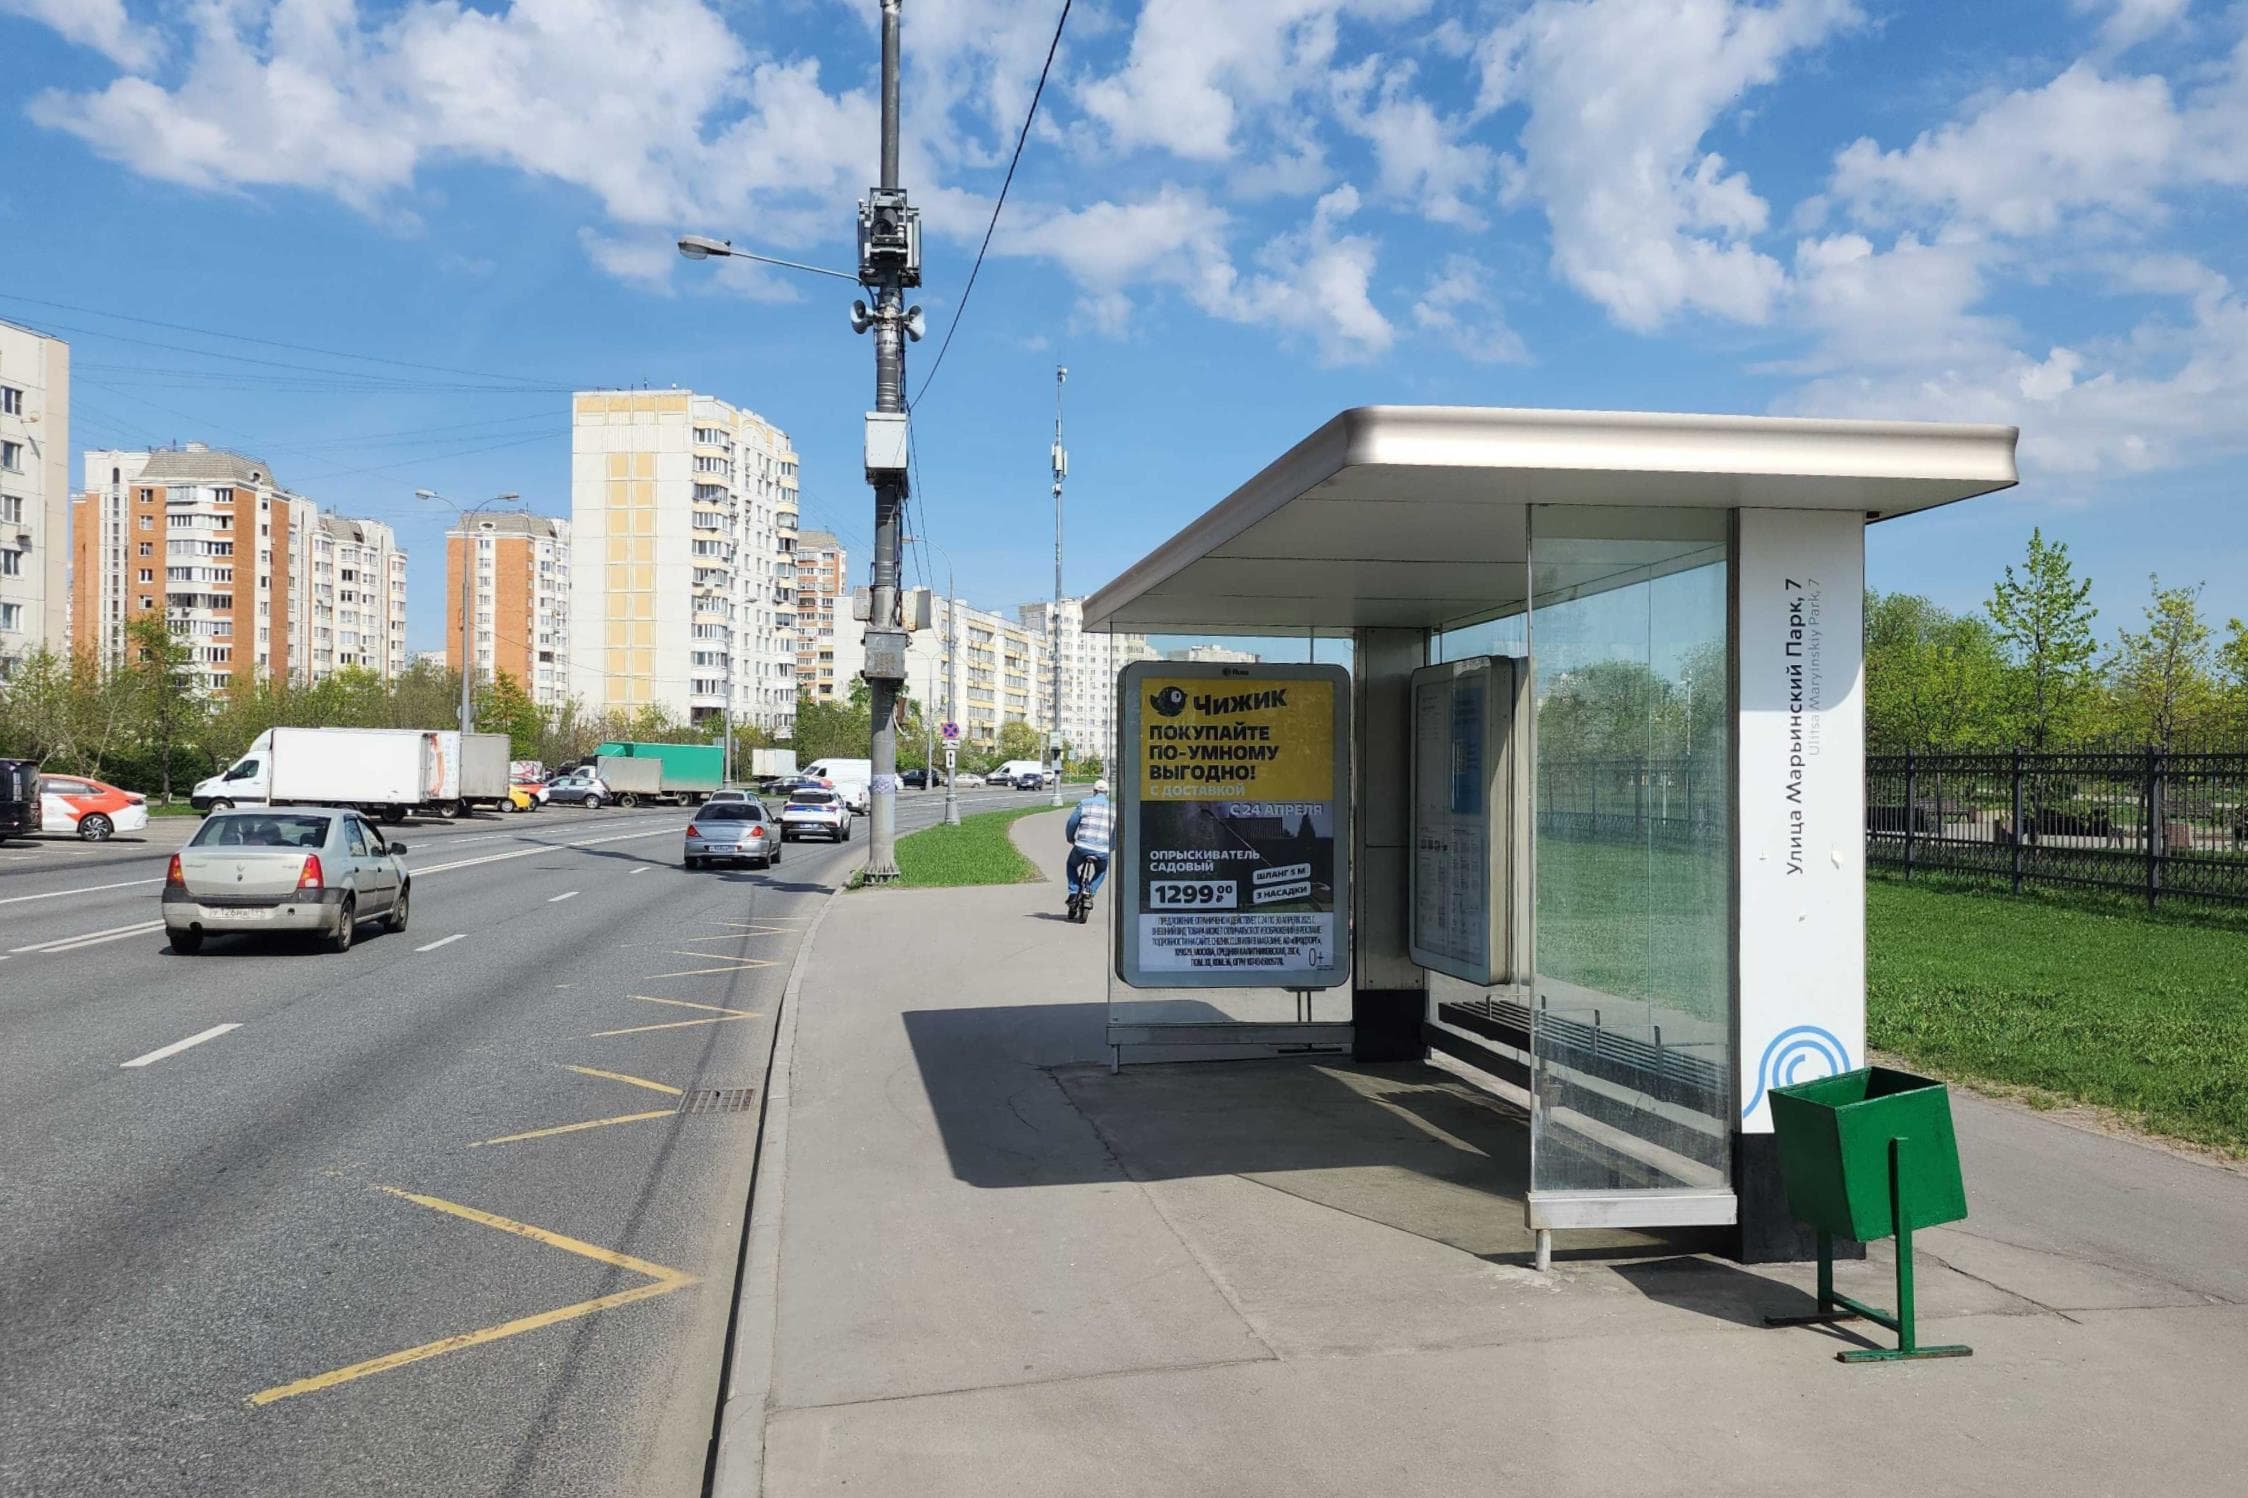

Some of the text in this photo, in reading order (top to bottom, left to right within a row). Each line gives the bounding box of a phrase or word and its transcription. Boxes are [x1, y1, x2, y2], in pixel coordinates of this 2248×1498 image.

[1808, 579, 1820, 587] 7
[1808, 630, 1823, 710] Maryinskiy
[1149, 722, 1270, 740] ПОКУПАЙТЕ
[1785, 579, 1805, 875] Улица Марьинский Парк, 7
[1808, 714, 1820, 756] Ulitsa
[1149, 745, 1279, 760] ПО-УМНОМУ
[1149, 765, 1255, 782] ВЫГОДНО!
[1161, 783, 1246, 797] ДОСТАВКОЙ
[1242, 804, 1261, 815] 24
[1264, 804, 1322, 815] АПРЕЛЯ
[1150, 850, 1260, 860] ОПРЫСКИВАТЕЛЬ
[1150, 860, 1214, 873] САДОВЫЙ
[1256, 869, 1289, 880] ШЛАНГ
[1264, 886, 1308, 898] НАСАДКИ
